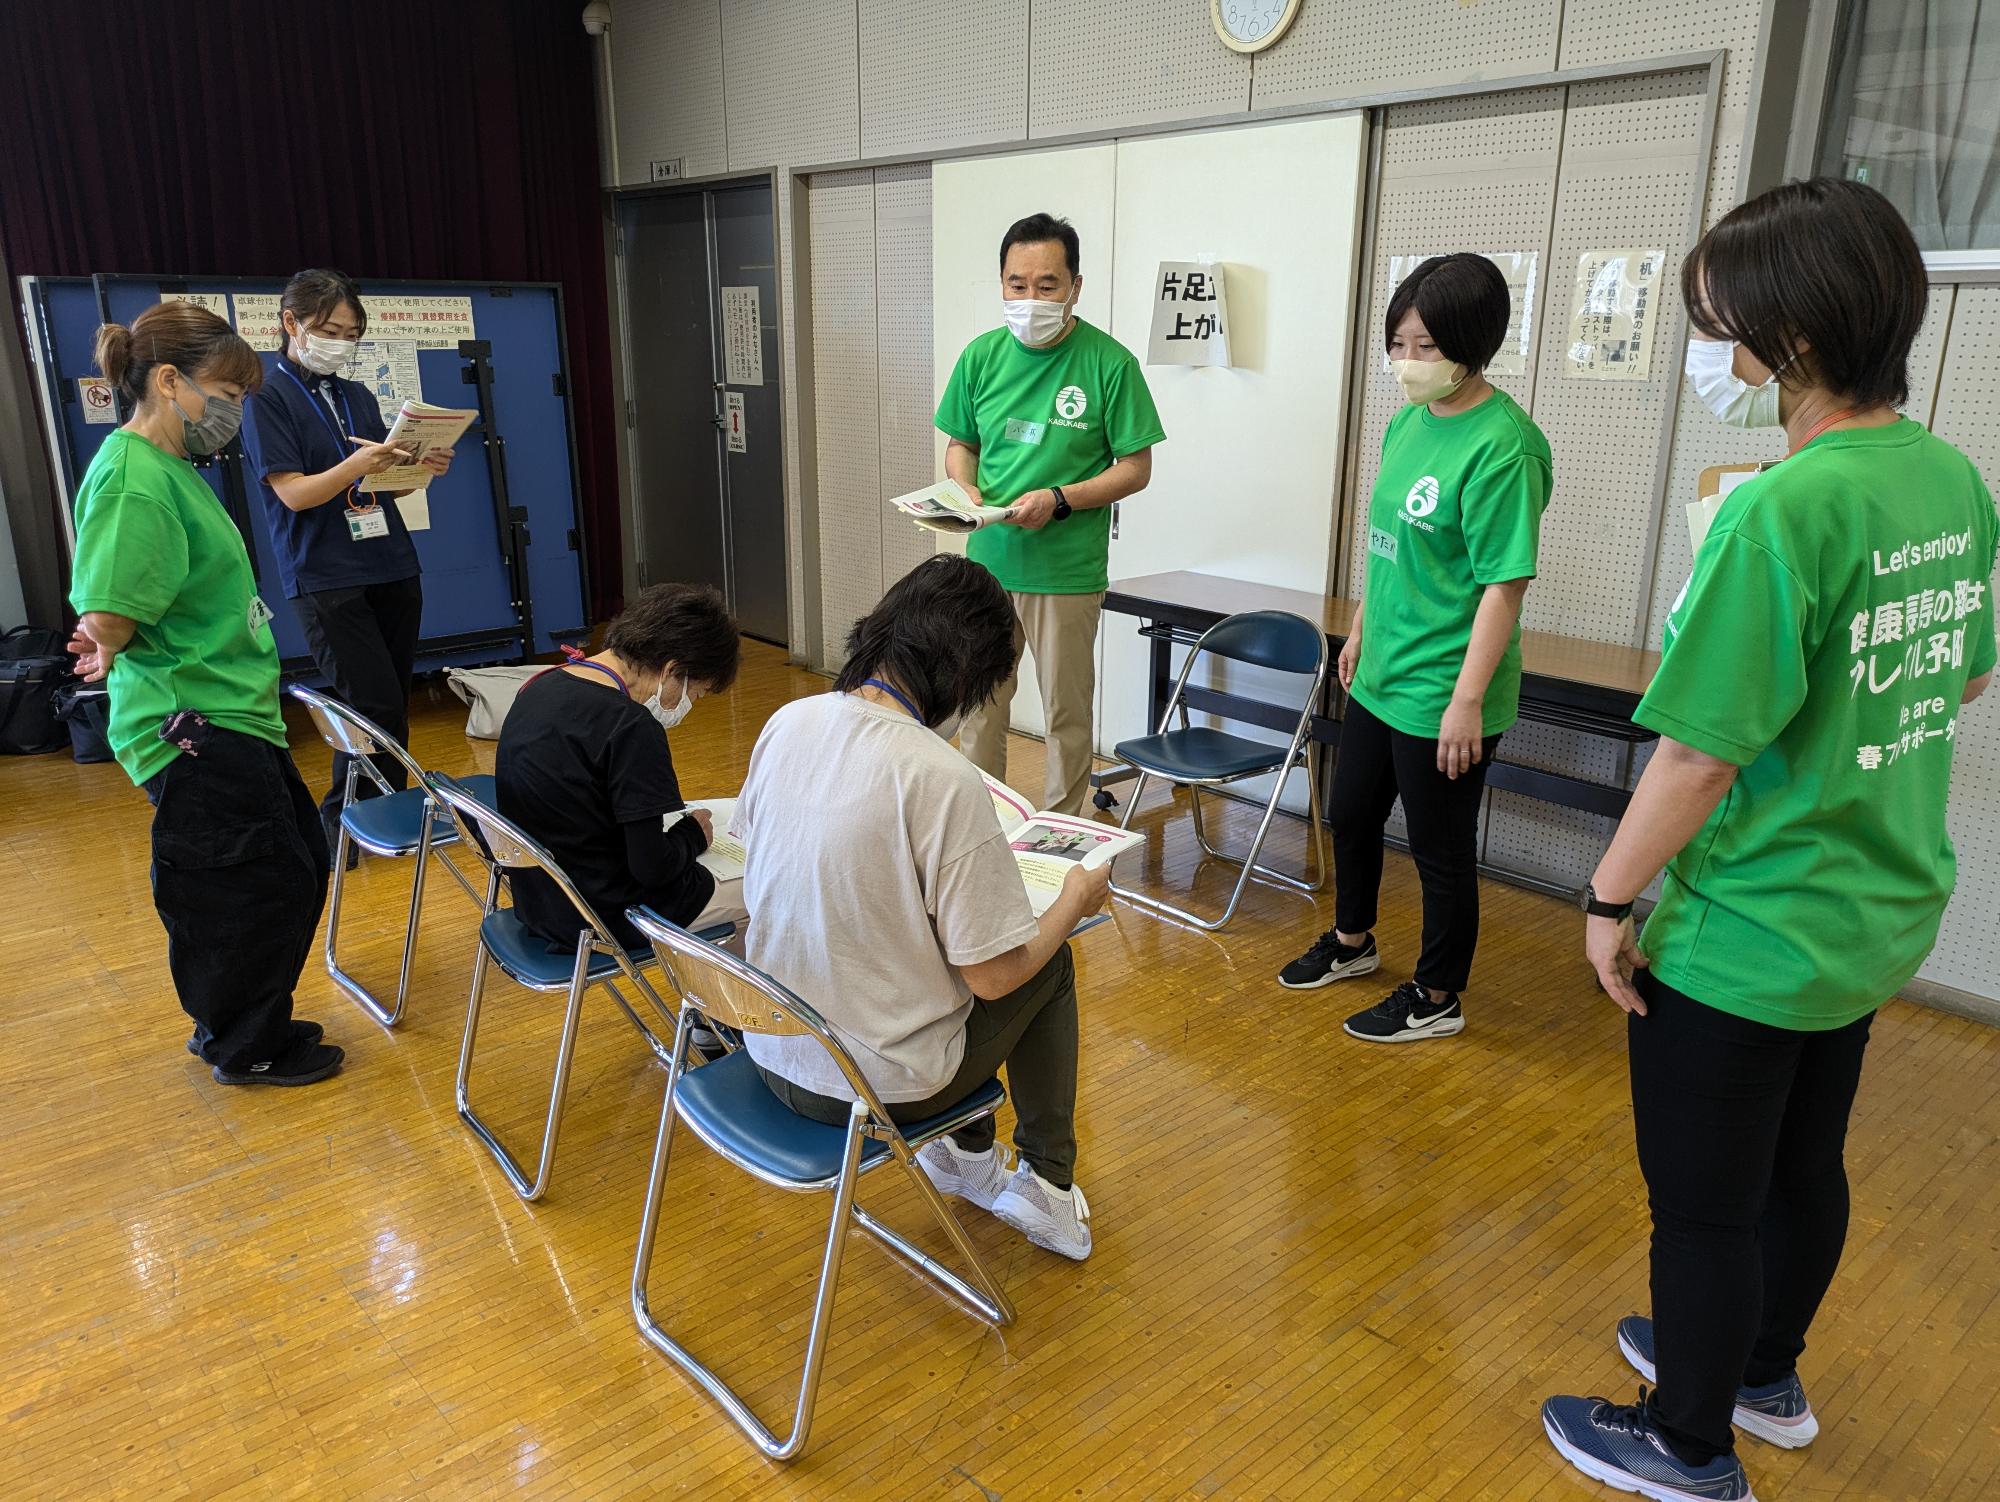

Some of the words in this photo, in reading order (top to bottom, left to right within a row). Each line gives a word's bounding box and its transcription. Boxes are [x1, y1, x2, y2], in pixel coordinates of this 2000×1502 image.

[1228, 5, 1238, 24] 8
[1263, 10, 1270, 31] 5
[1240, 15, 1247, 35] 7
[1248, 17, 1260, 36] 6
[1047, 417, 1089, 430] KASUKABE
[1873, 540, 1922, 576] Let's
[1923, 525, 1971, 561] enjoy!
[1913, 696, 1945, 719] are
